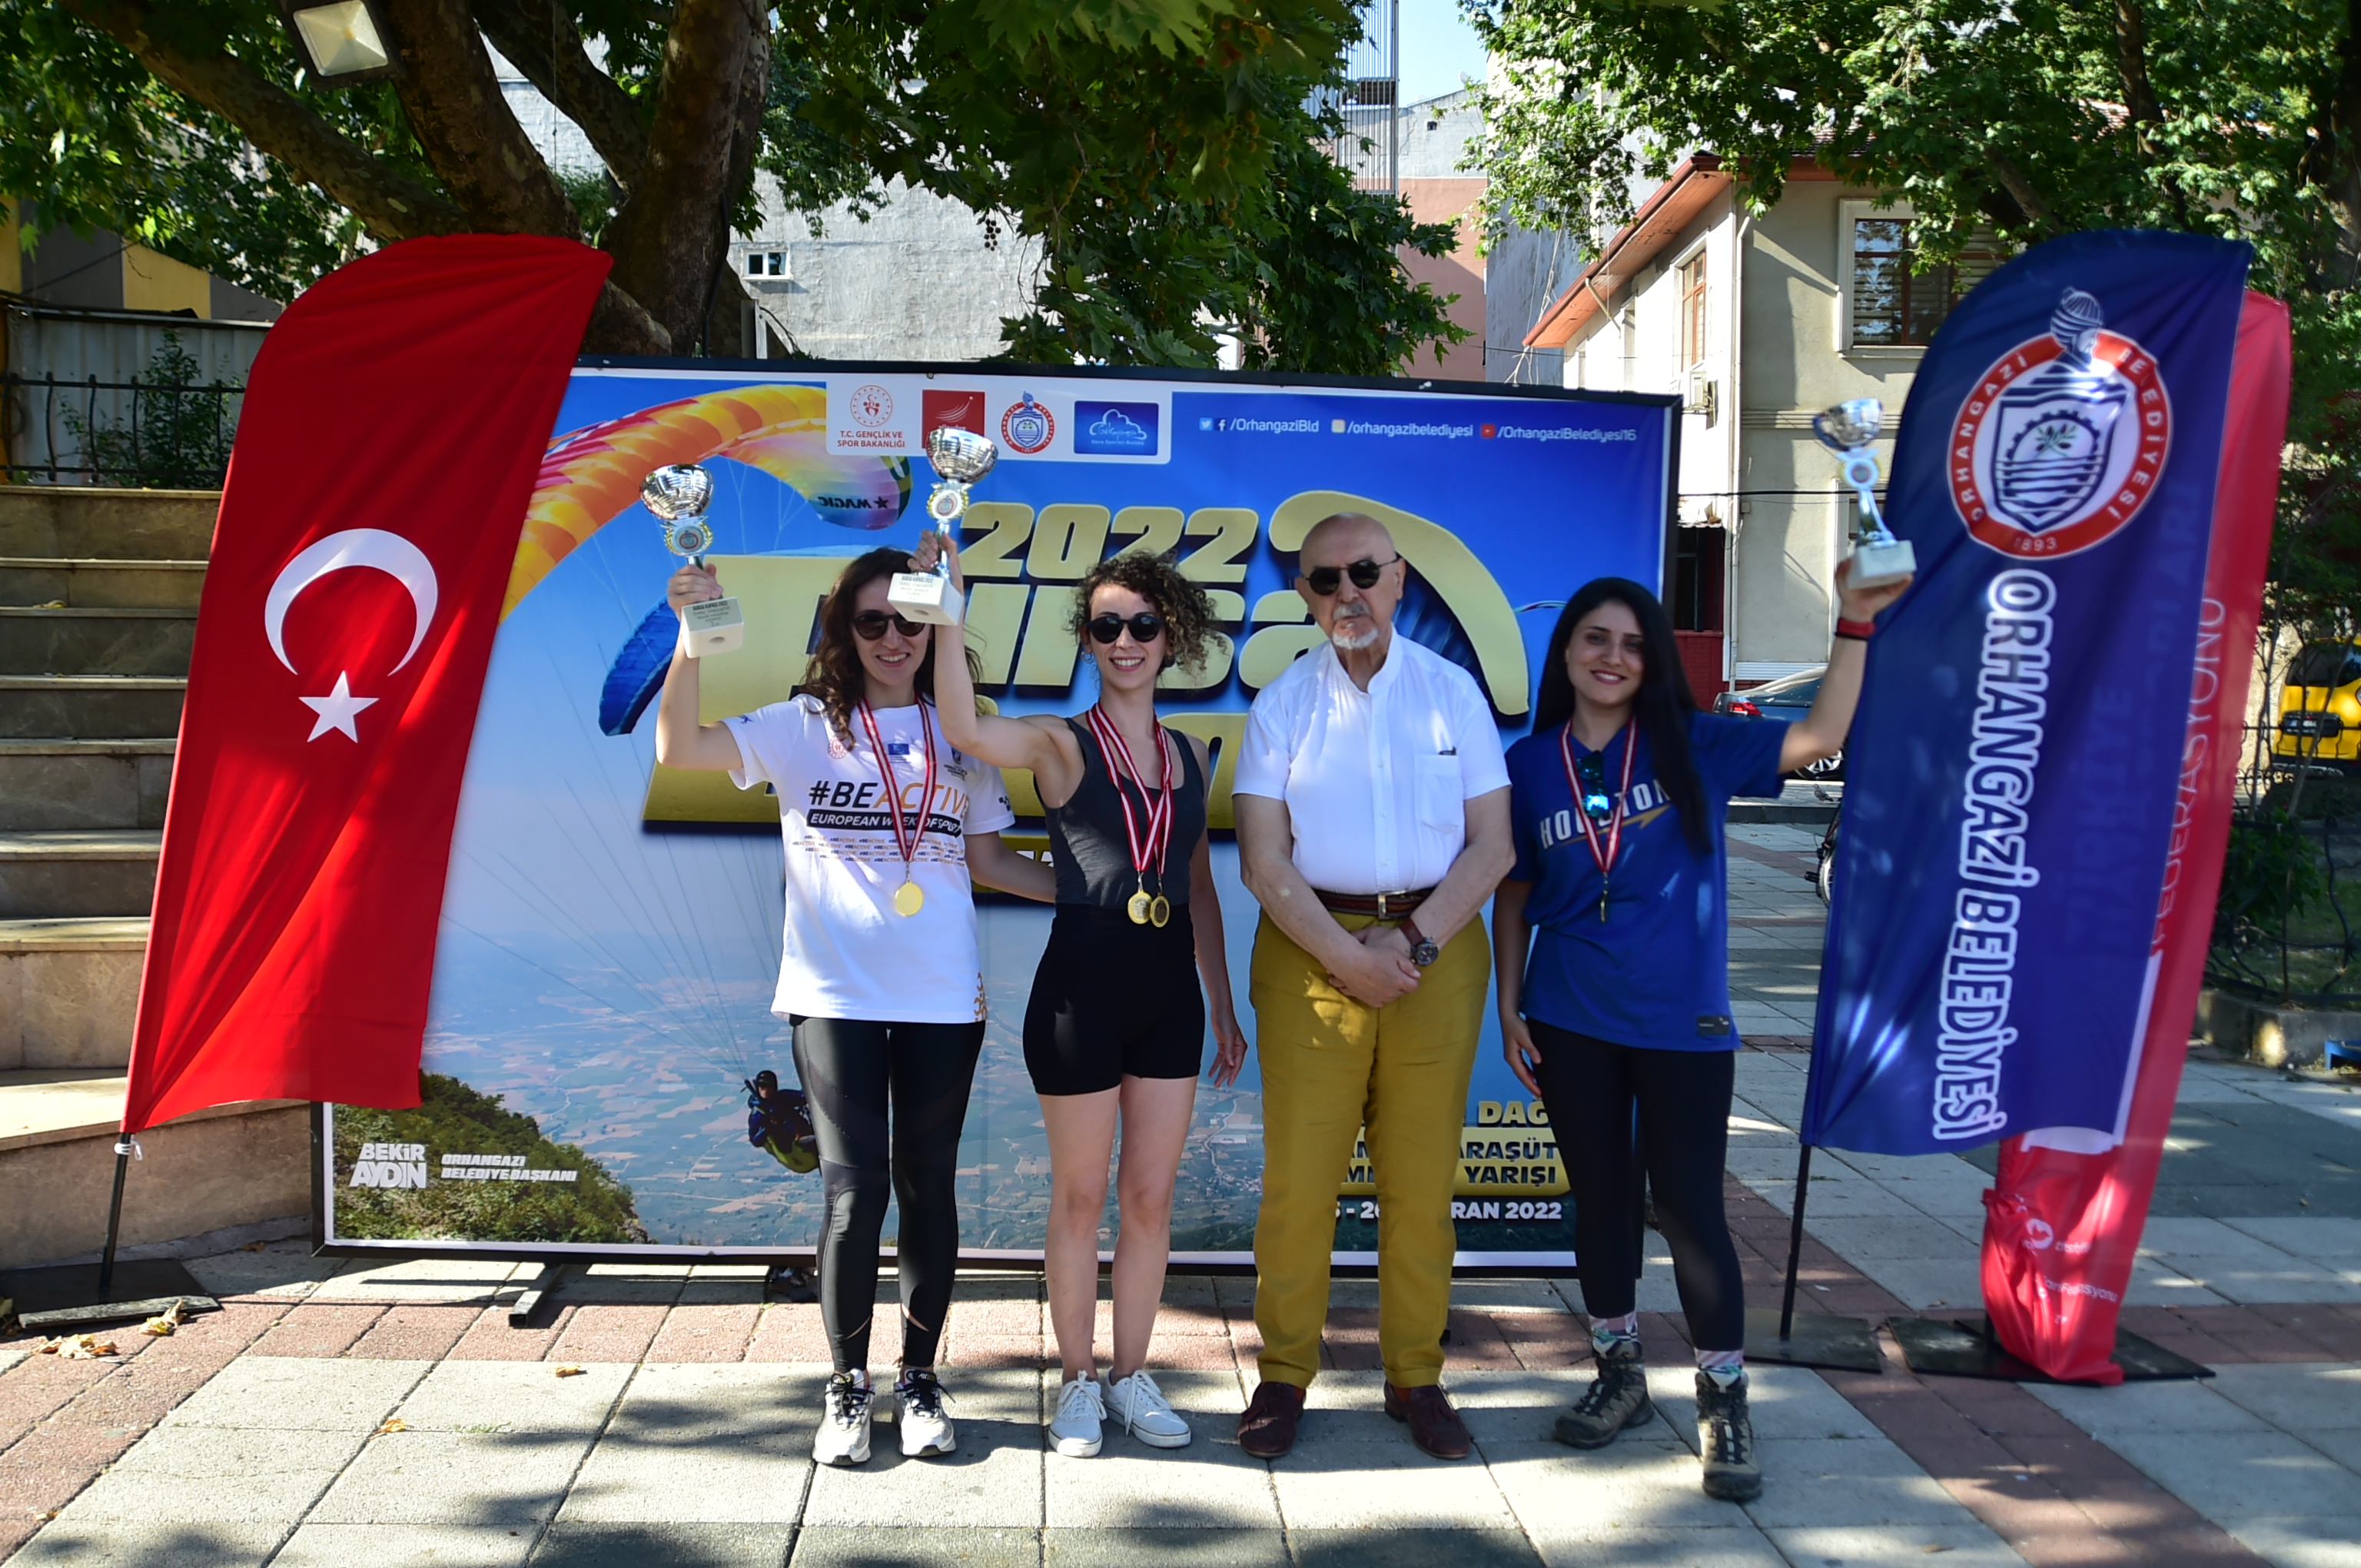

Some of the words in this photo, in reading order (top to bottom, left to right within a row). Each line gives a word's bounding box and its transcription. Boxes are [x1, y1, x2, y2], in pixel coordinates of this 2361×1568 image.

[855, 430, 891, 440] GENÇLİK
[1230, 418, 1320, 433] /OrhangaziBld
[1347, 421, 1474, 439] /orhangazibelediyesi
[2107, 348, 2166, 520] BEEDİYESİ
[860, 439, 905, 448] BAKANLIĞI
[959, 500, 1259, 583] 2022
[2014, 537, 2057, 552] 1893
[1960, 569, 2057, 890] ORHANGAZİ
[810, 813, 879, 826] EUROPEAN
[882, 816, 918, 827] WEK
[1539, 778, 1671, 850] HOUTON
[1933, 888, 2021, 1141] BELEDİYESİ
[1459, 1138, 1556, 1162] RAŞÜT
[350, 1161, 427, 1188] AYDIN
[510, 1170, 577, 1183] BAŞKANI
[1464, 1166, 1556, 1188] YARIŞI
[1505, 1202, 1562, 1220] 2022
